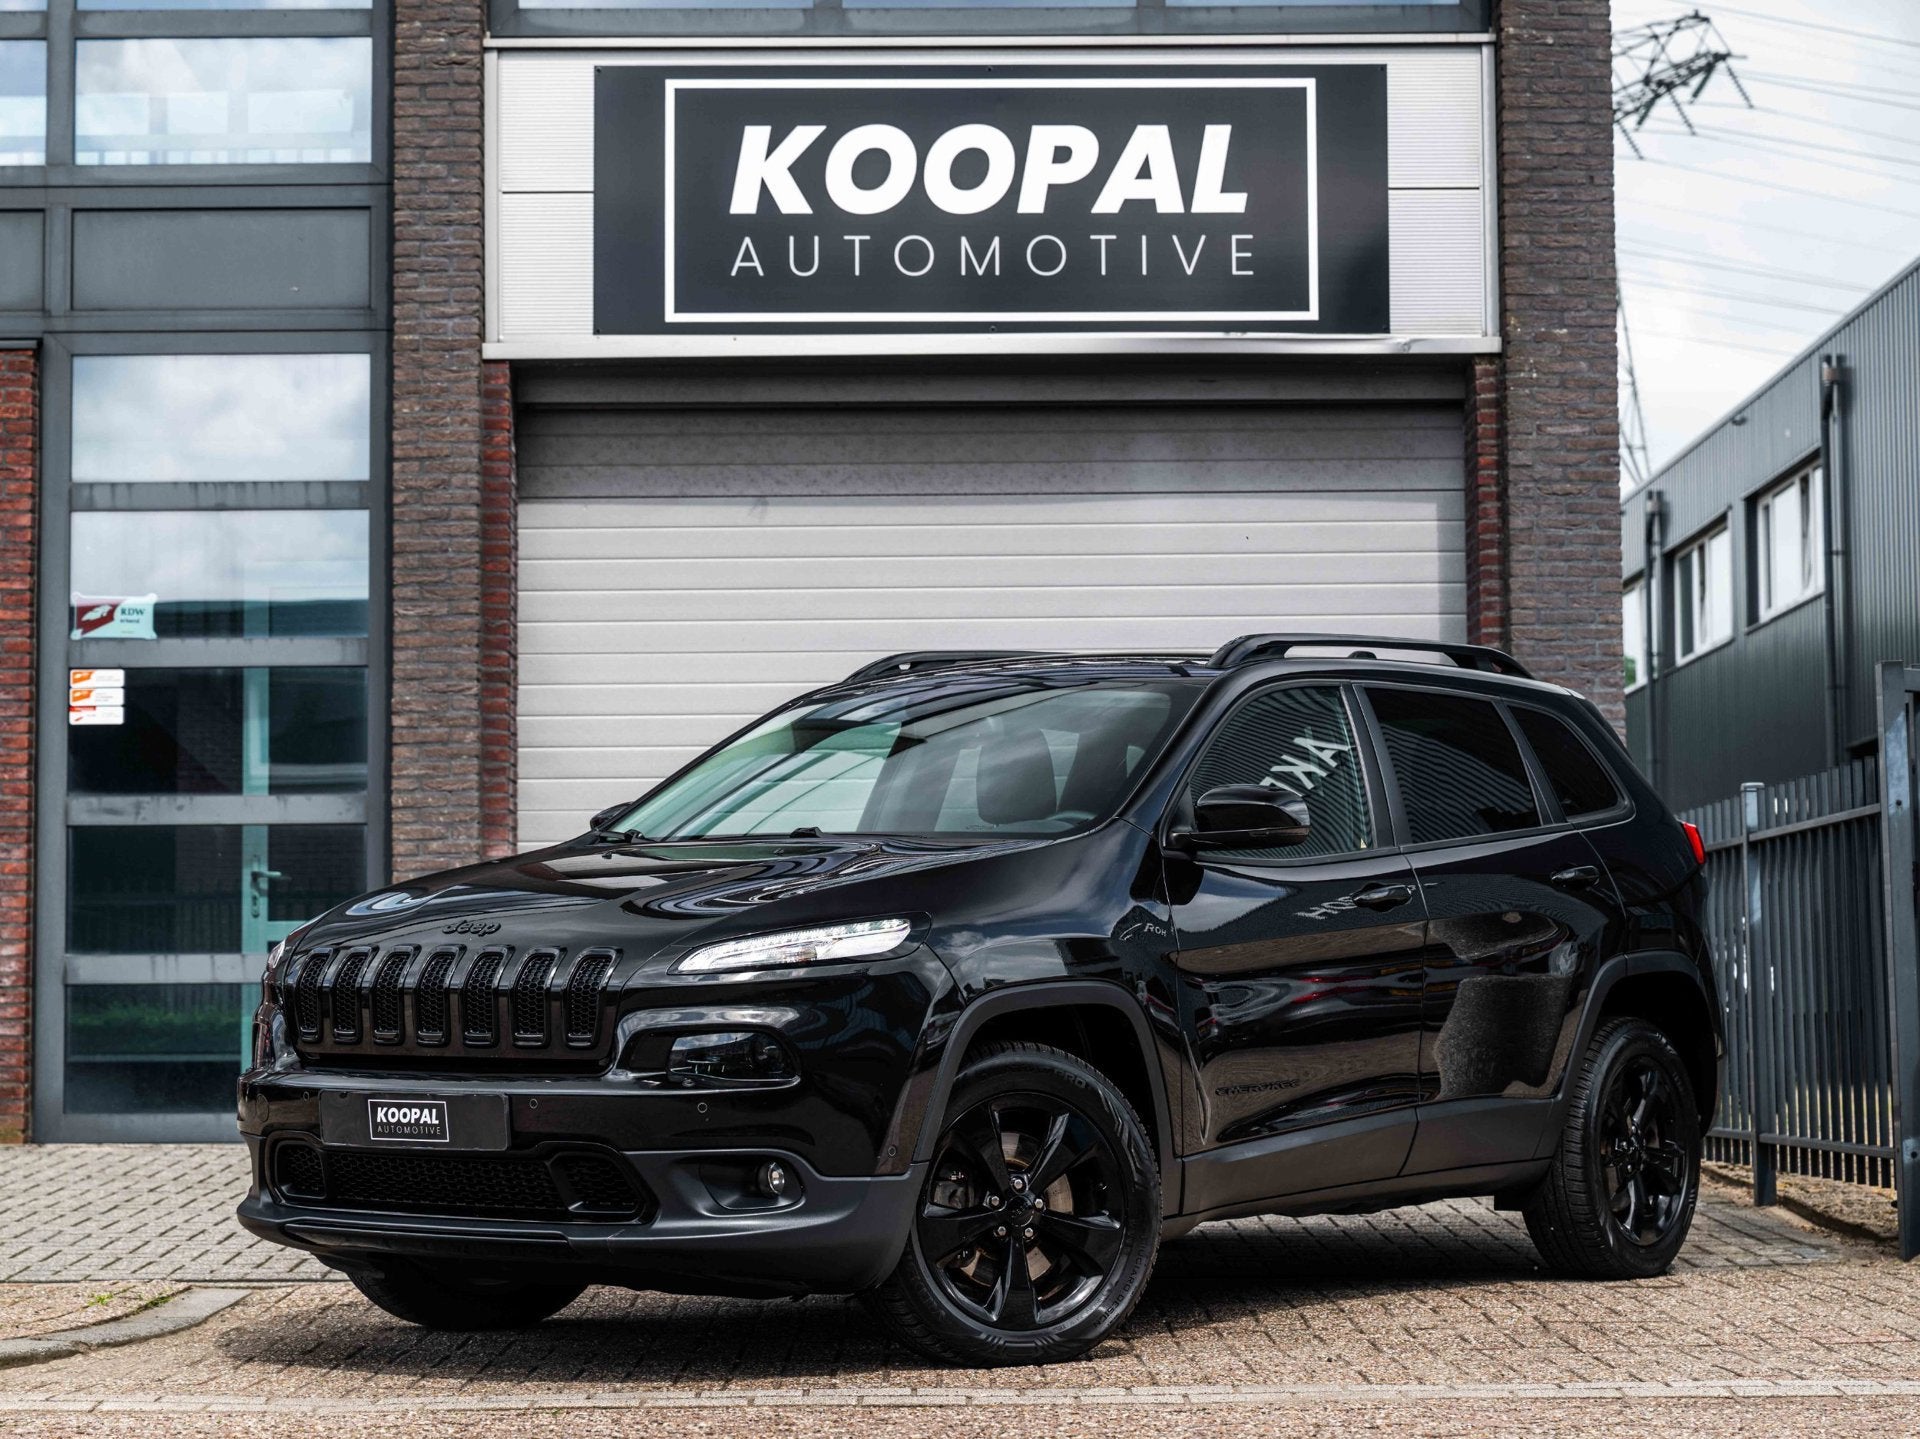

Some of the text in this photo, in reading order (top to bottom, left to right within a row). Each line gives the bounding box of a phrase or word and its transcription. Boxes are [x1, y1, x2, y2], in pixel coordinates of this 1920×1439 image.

[730, 124, 1248, 215] KOOPAL
[730, 234, 1255, 278] AUTOMOTIVE
[120, 607, 146, 616] RDW
[442, 919, 501, 937] Jeep
[376, 1106, 440, 1125] KOOPAL
[377, 1125, 441, 1136] AUTOMOTIVE
